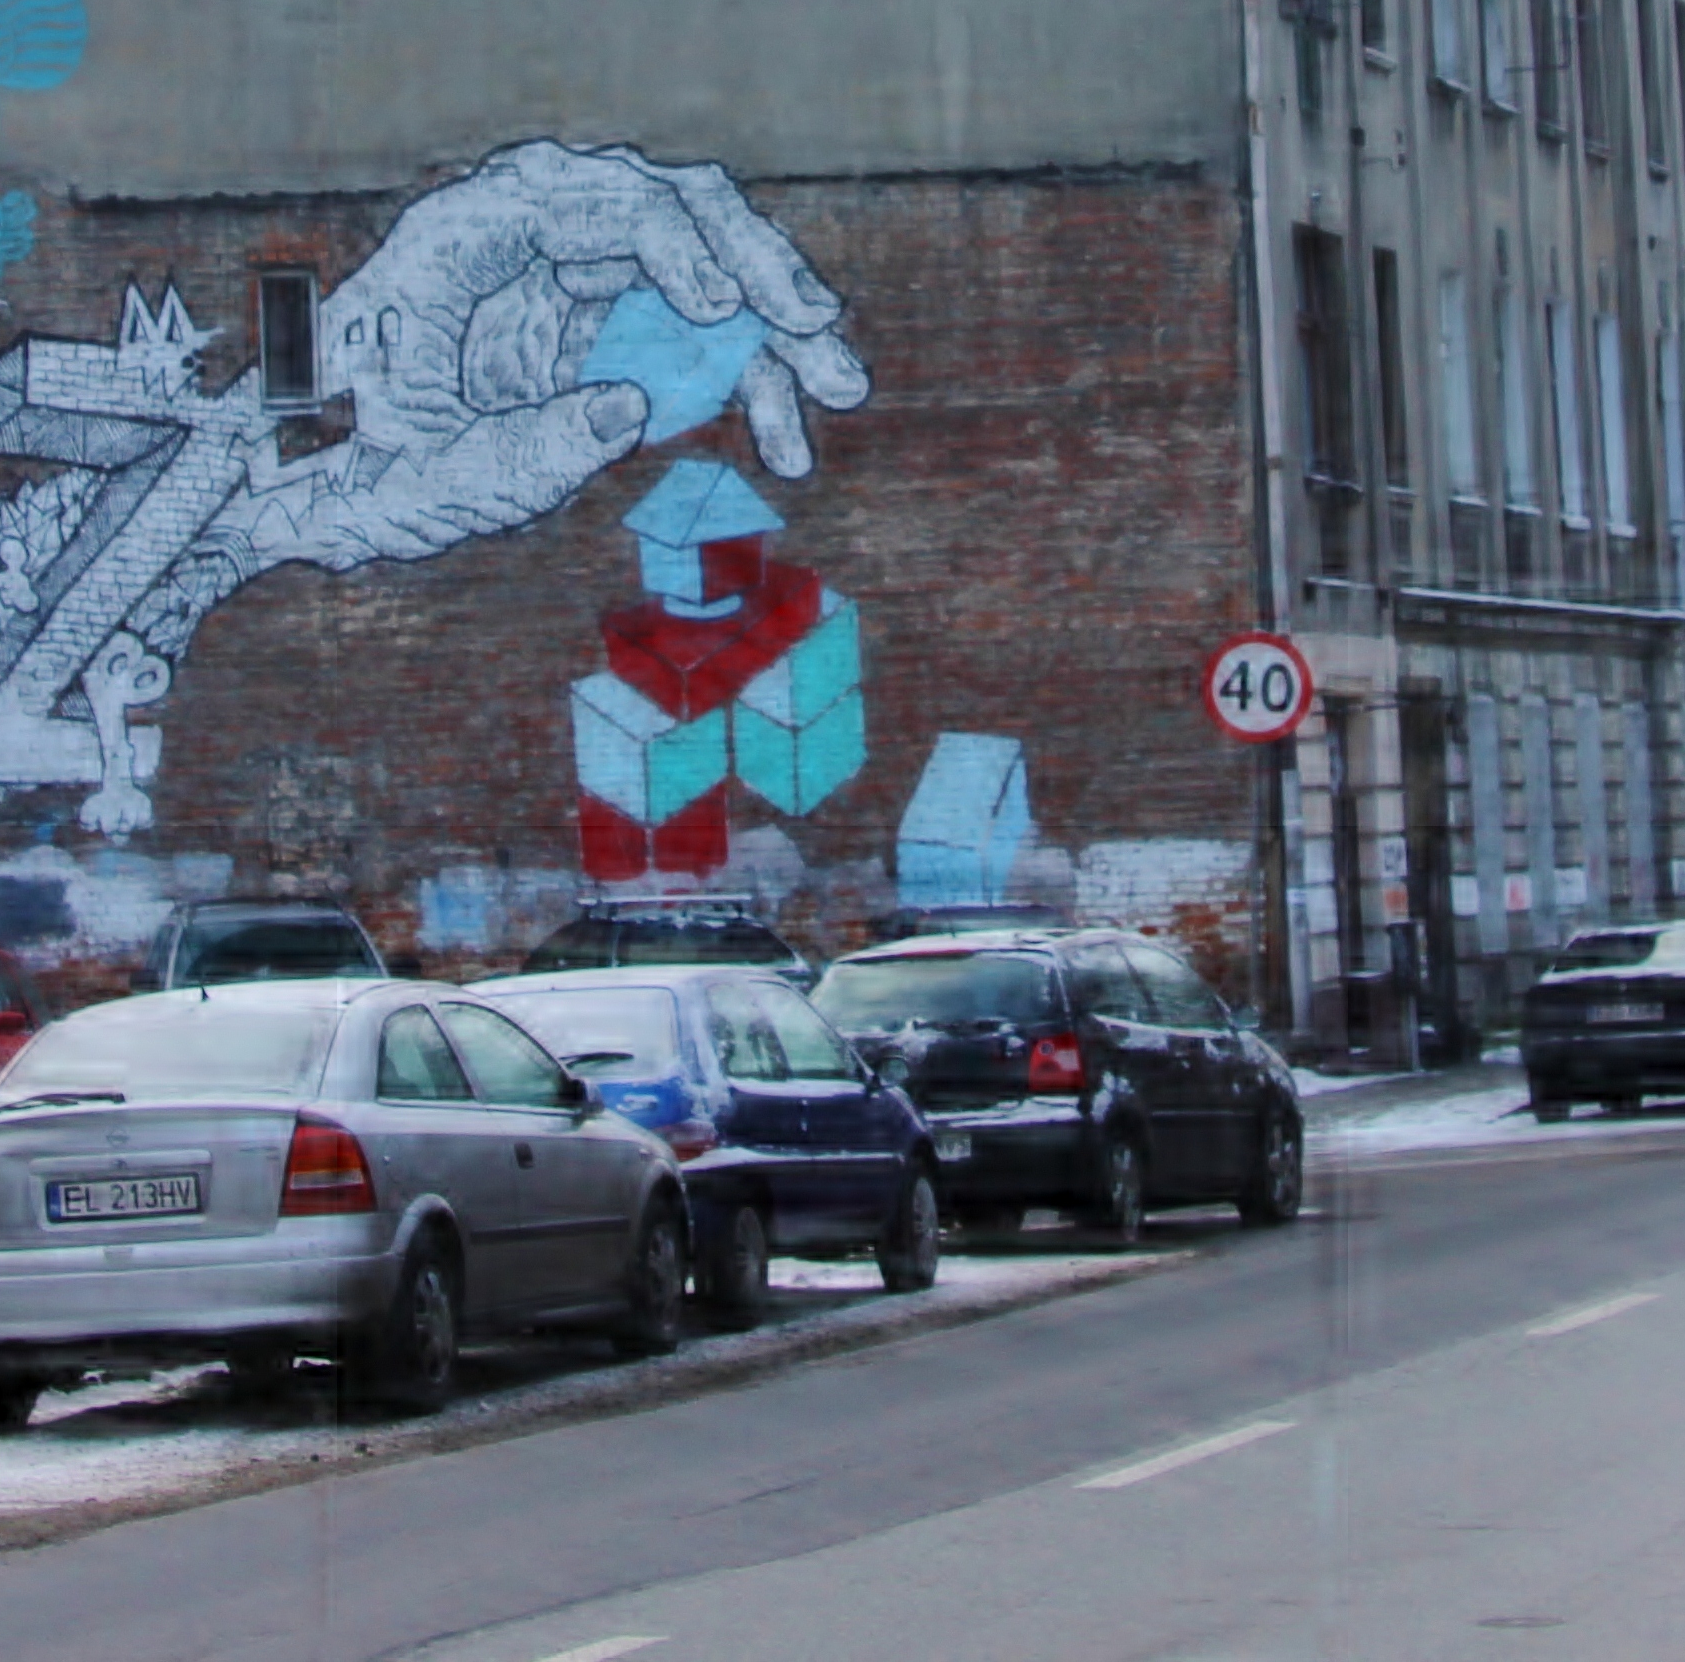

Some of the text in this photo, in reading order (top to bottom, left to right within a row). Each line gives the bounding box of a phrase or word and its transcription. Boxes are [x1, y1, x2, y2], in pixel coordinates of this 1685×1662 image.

[1219, 660, 1294, 712] 40
[64, 1179, 191, 1214] EL 213HV
